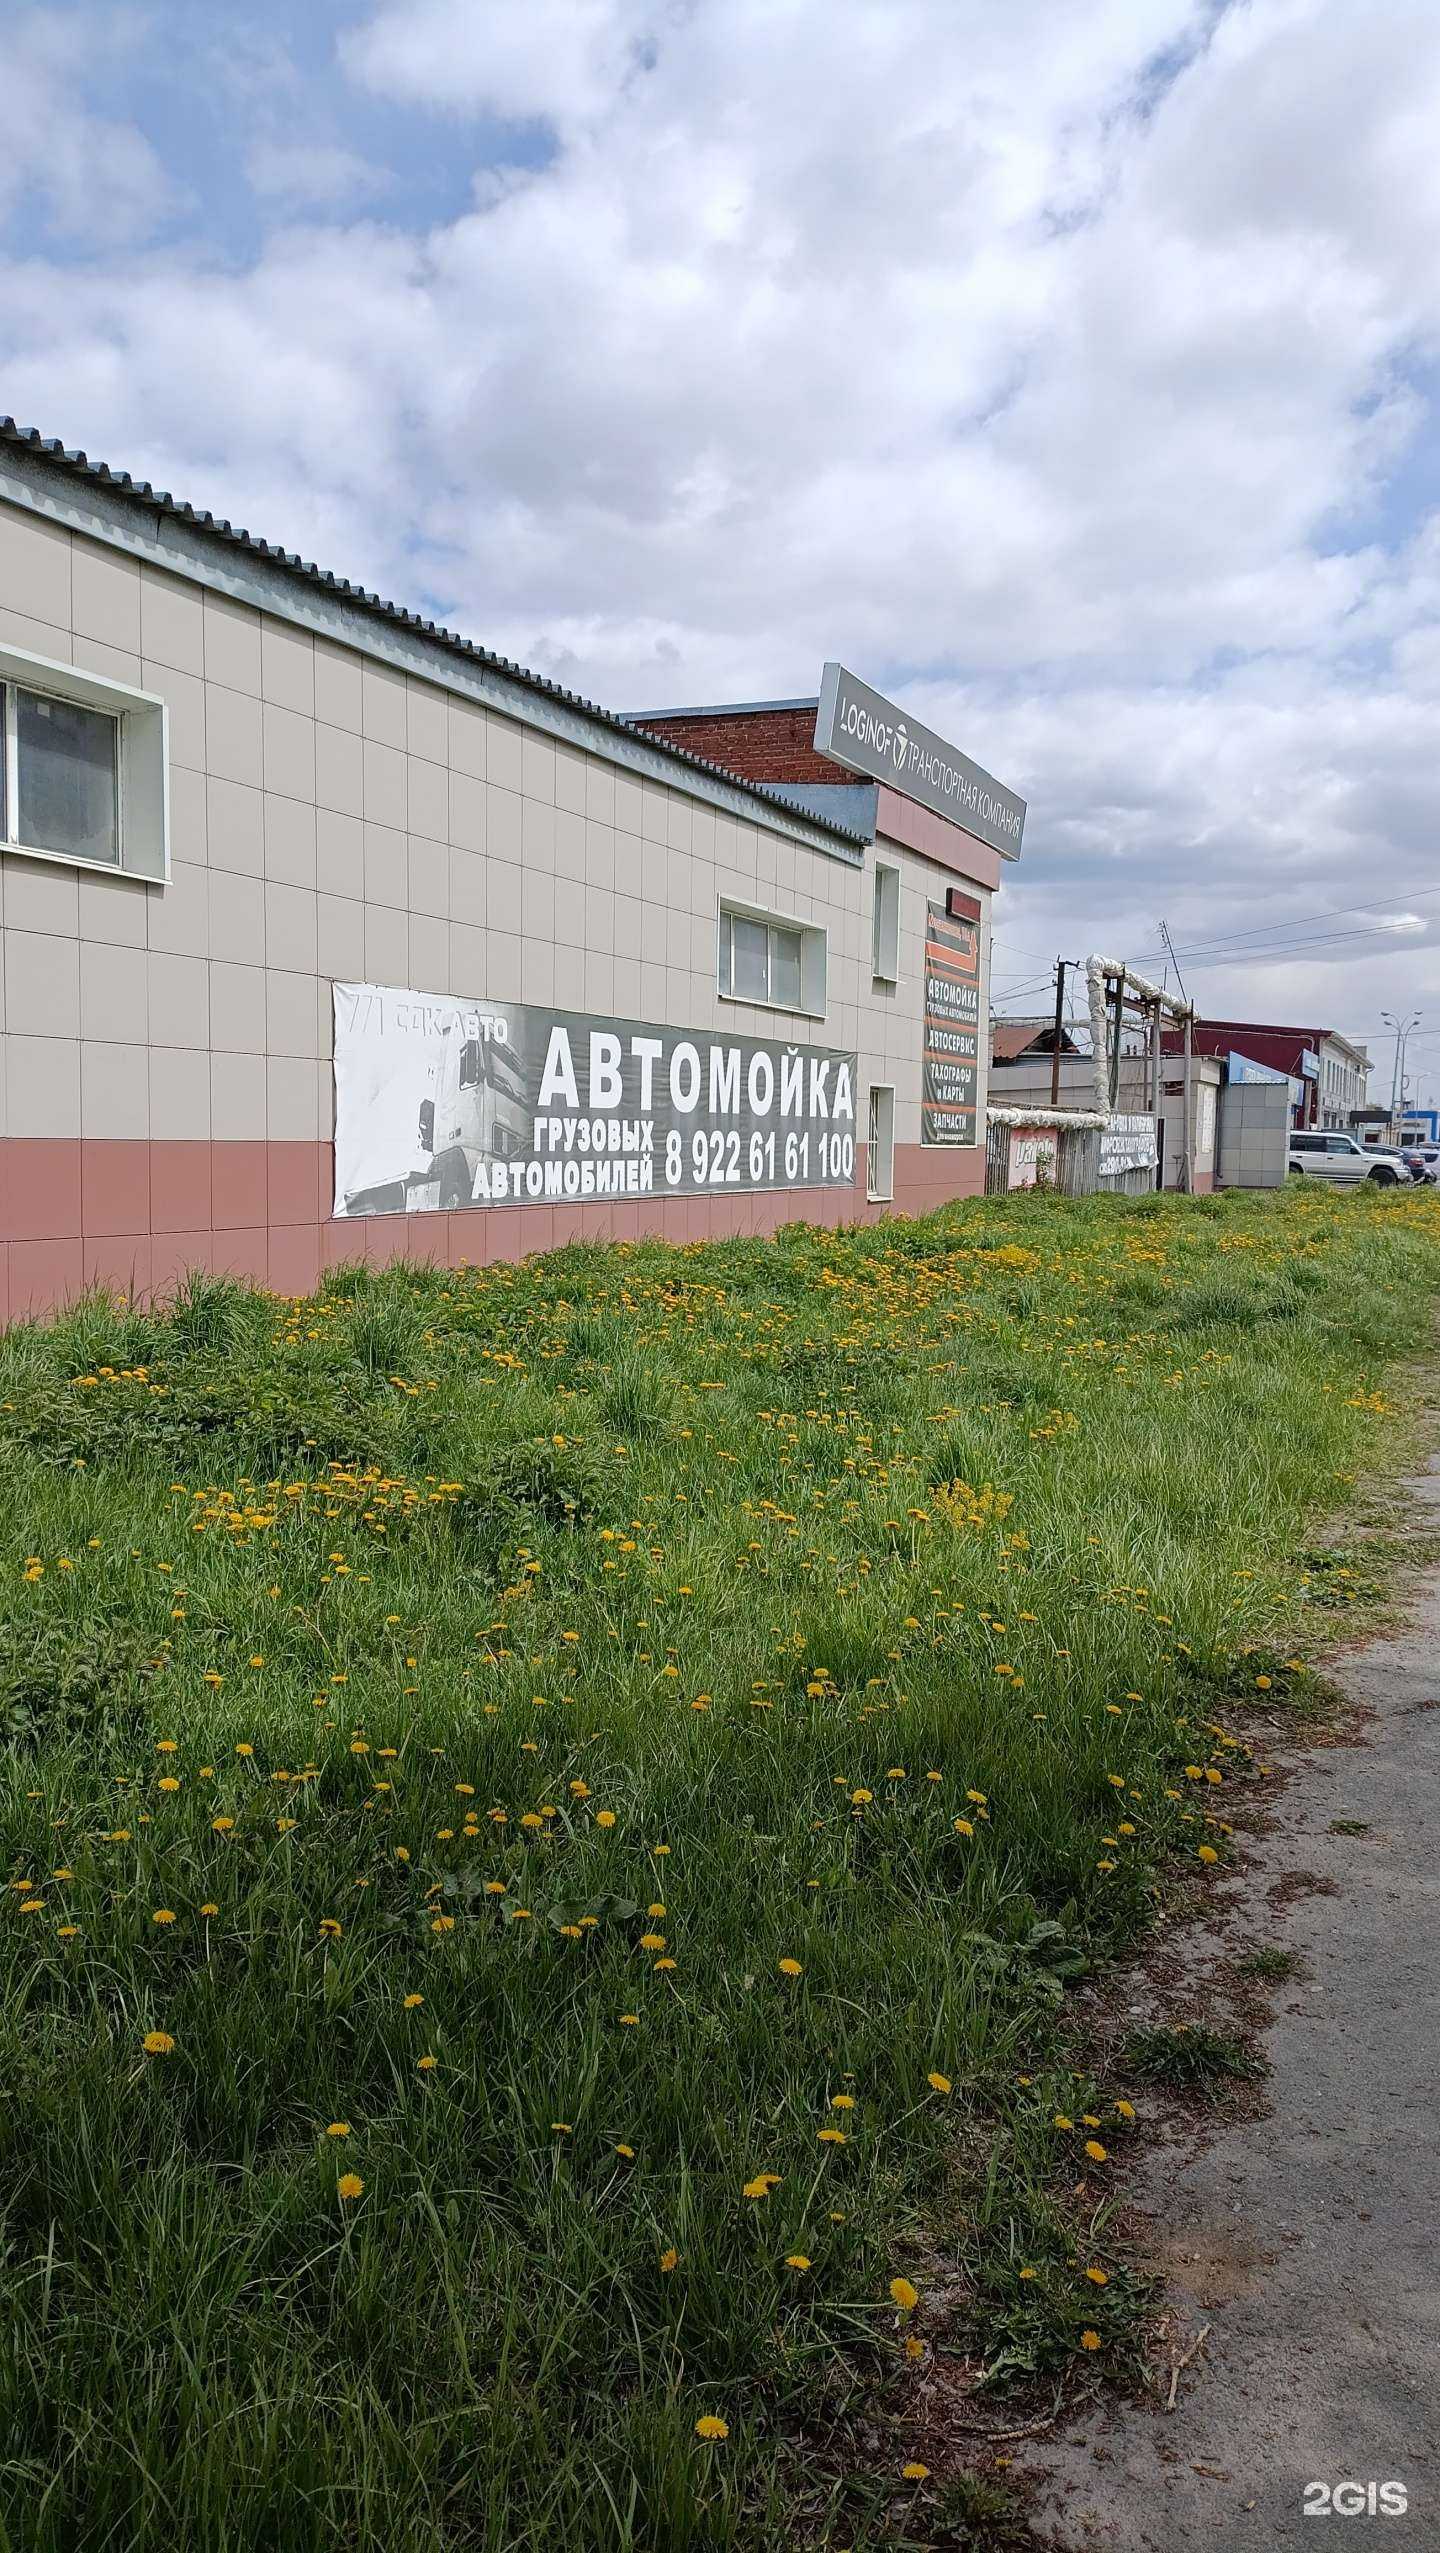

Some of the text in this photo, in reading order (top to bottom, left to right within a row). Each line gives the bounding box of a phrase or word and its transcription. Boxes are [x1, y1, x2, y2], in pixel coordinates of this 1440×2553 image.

[907, 741, 1021, 840] ТРАНСПОРТНАЯ КОМПАНИЯ
[928, 978, 977, 1009] АВТОМОЙКА
[928, 1029, 975, 1055] АВТОСЕРВИС
[537, 1026, 855, 1120] АВТОМОЙКА
[931, 1063, 972, 1083] ТАХОГРАФЫ
[943, 1085, 965, 1102] КАРТЫ
[533, 1117, 655, 1153] ГРУЗОВЫХ
[933, 1112, 967, 1130] ЗАПЧАСТИ
[665, 1129, 854, 1185] 8 922 61 61 100
[471, 1153, 654, 1200] АВТОМОБИЛЕЙ
